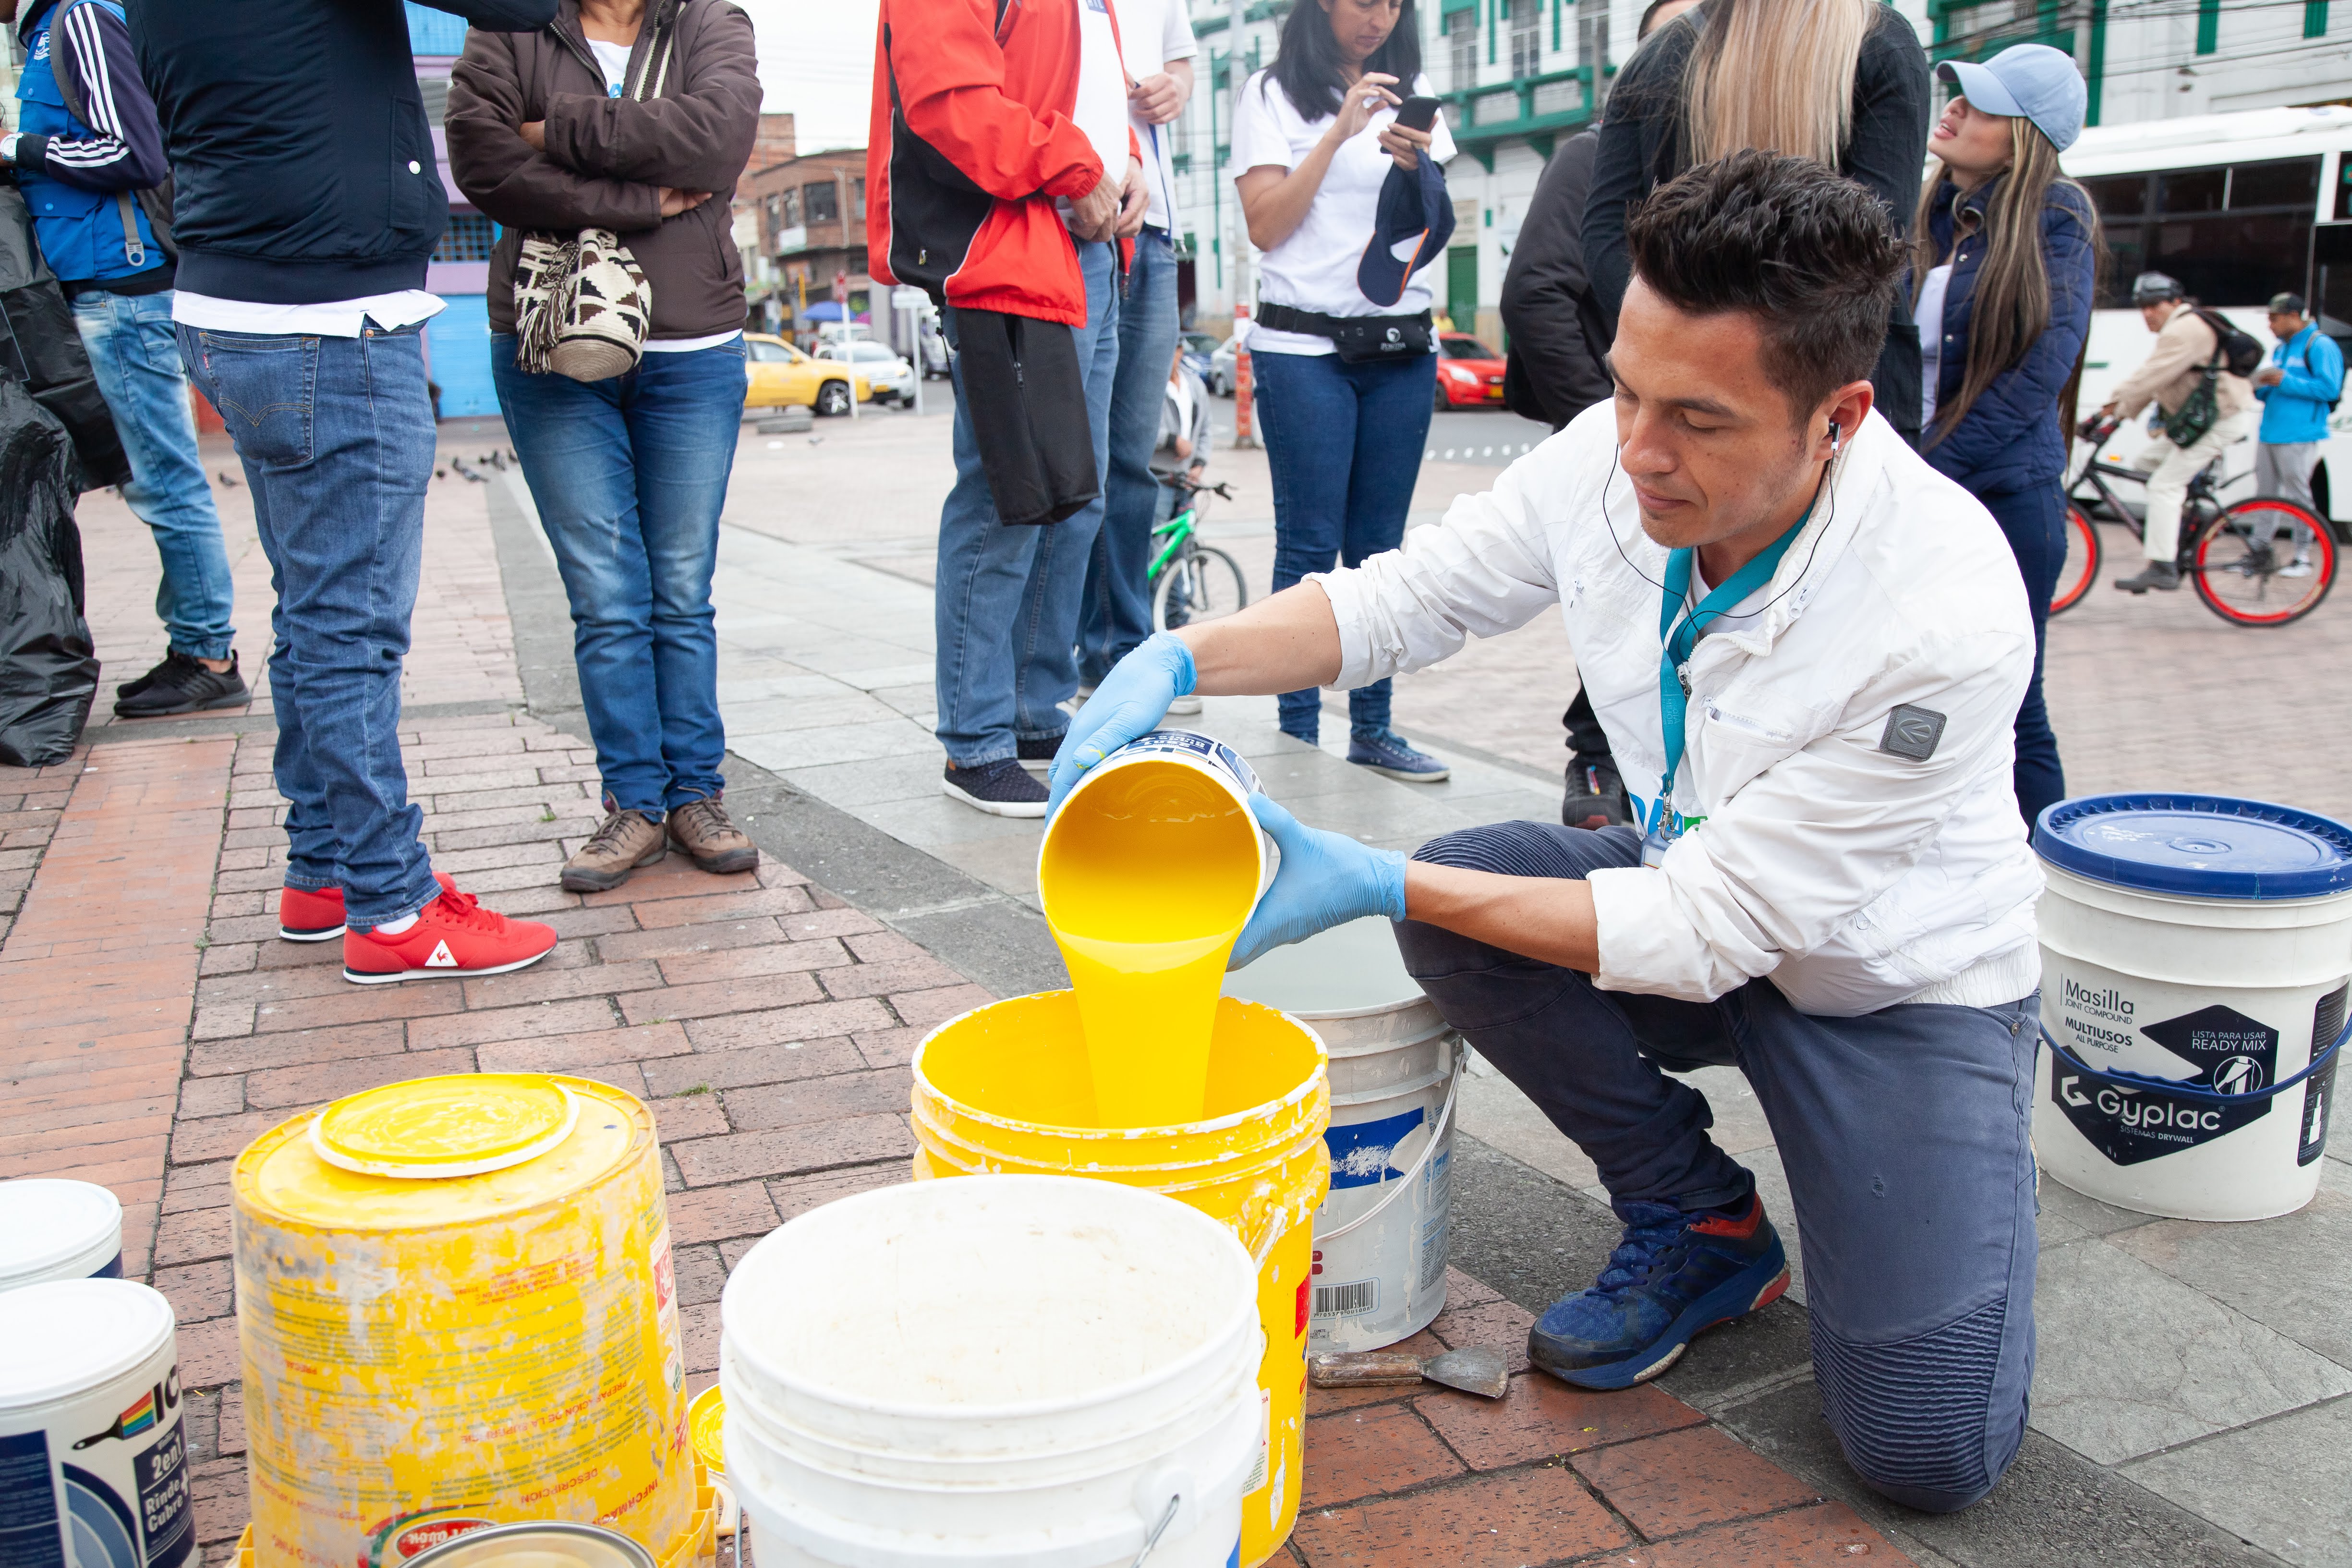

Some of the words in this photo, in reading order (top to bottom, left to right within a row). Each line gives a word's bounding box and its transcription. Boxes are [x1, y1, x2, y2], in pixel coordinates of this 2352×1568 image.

[2065, 997, 2083, 1011] JOINT
[2084, 1004, 2133, 1025] COMPOUND
[2066, 978, 2134, 1015] Masilla
[2065, 1016, 2133, 1047] MULTIUSOS
[2075, 1033, 2085, 1045] ALL
[2087, 1037, 2119, 1054] PURPOSE
[2192, 1030, 2216, 1039] LISTA
[2218, 1032, 2242, 1040] PARA
[2244, 1031, 2266, 1040] USAR
[2192, 1039, 2238, 1051] READY
[2242, 1039, 2267, 1051] MIX
[2097, 1089, 2221, 1130] Gyplac
[2120, 1125, 2156, 1139] SISTEMAS
[2158, 1132, 2194, 1143] DRYWALL
[145, 1478, 180, 1515] Rinde
[146, 1494, 183, 1533] Cubre
